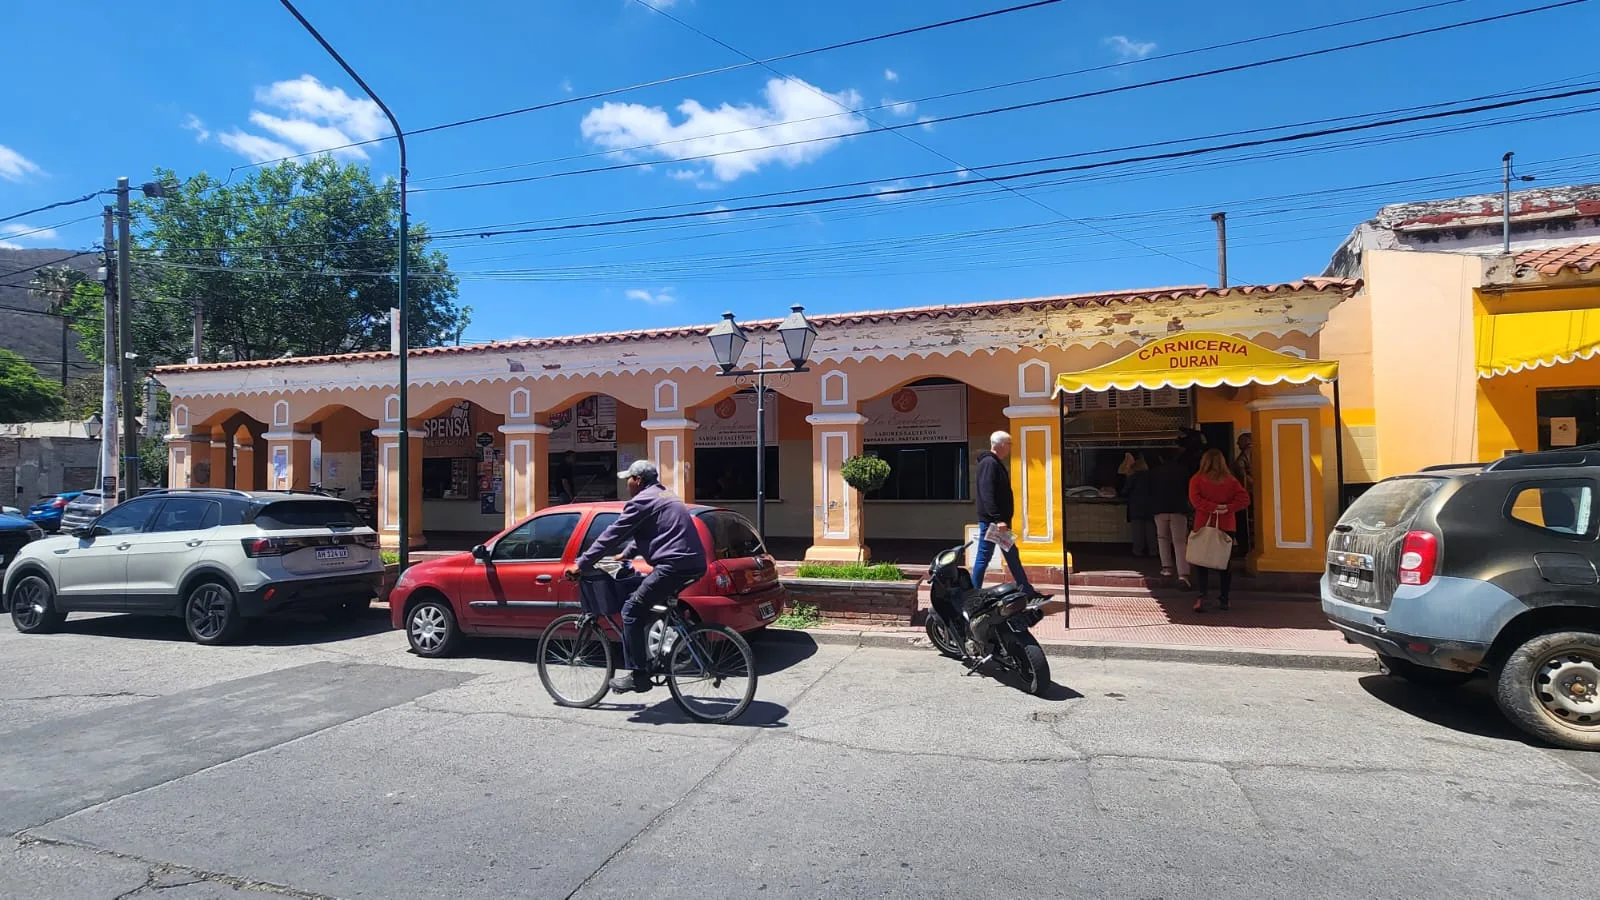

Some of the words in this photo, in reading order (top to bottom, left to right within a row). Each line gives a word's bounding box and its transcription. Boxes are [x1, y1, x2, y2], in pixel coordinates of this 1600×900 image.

[1139, 340, 1248, 360] CARNICERIA
[1170, 355, 1218, 368] DURAN
[423, 418, 470, 438] SPENSA
